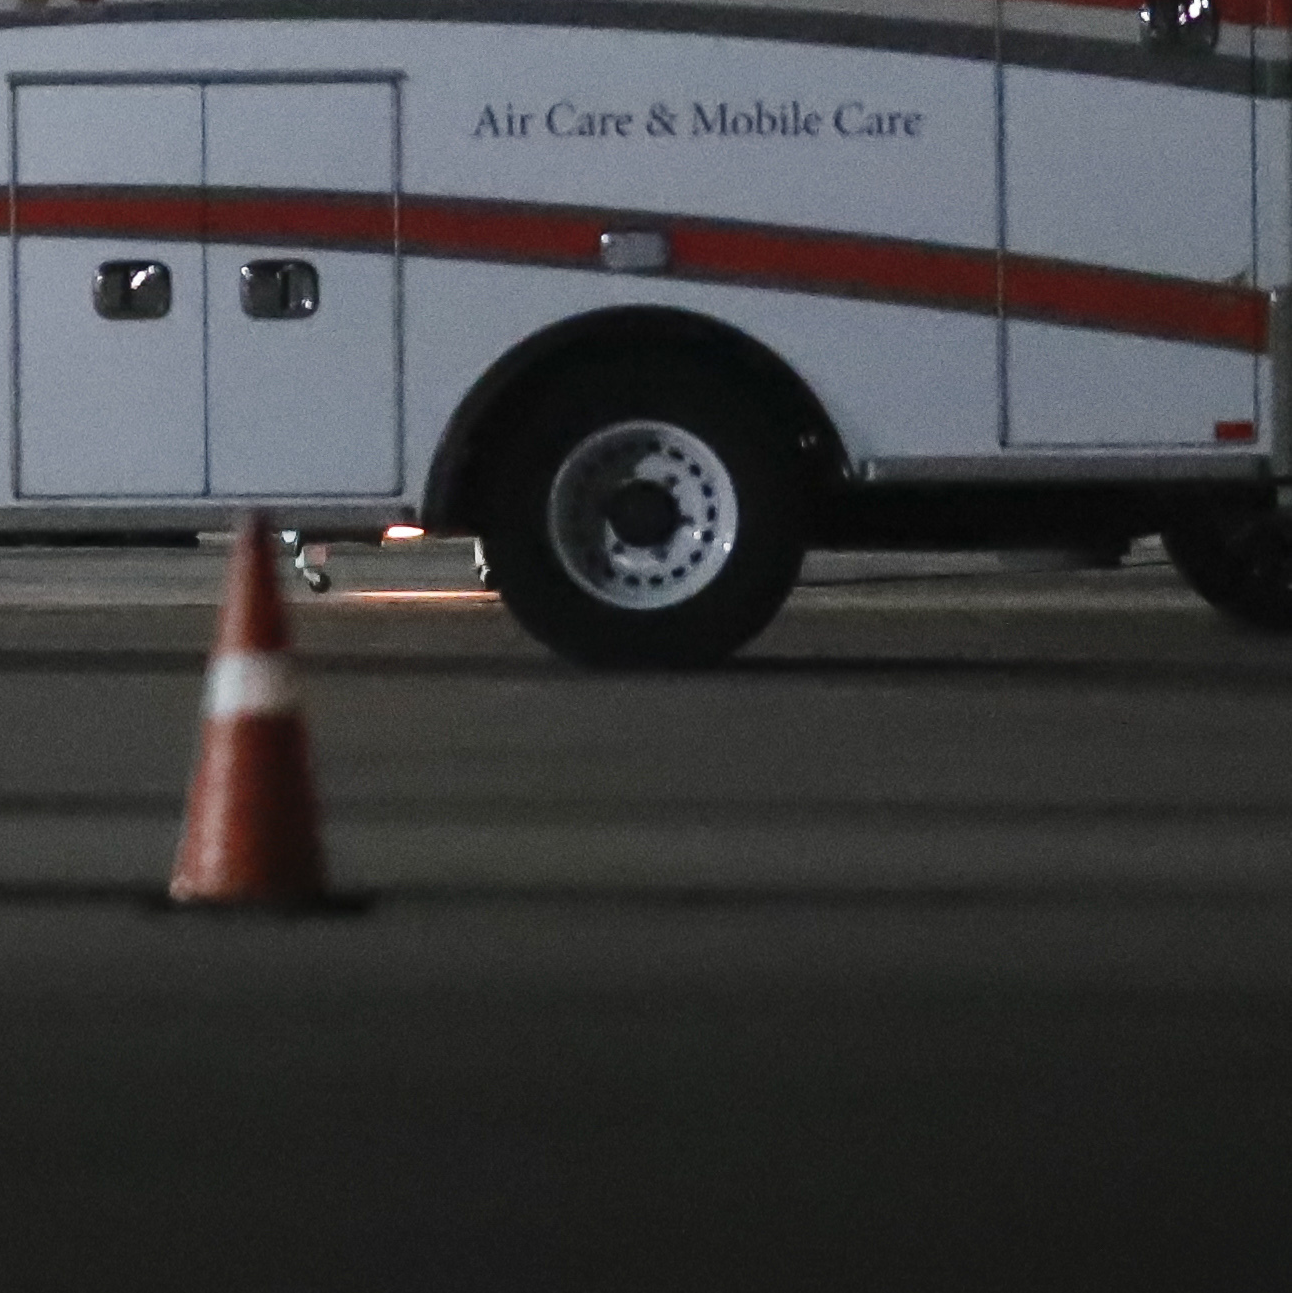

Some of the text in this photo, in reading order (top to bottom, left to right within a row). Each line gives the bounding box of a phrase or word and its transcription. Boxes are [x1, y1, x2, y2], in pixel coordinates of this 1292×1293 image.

[473, 100, 923, 138] Air Care & Mobile Care
